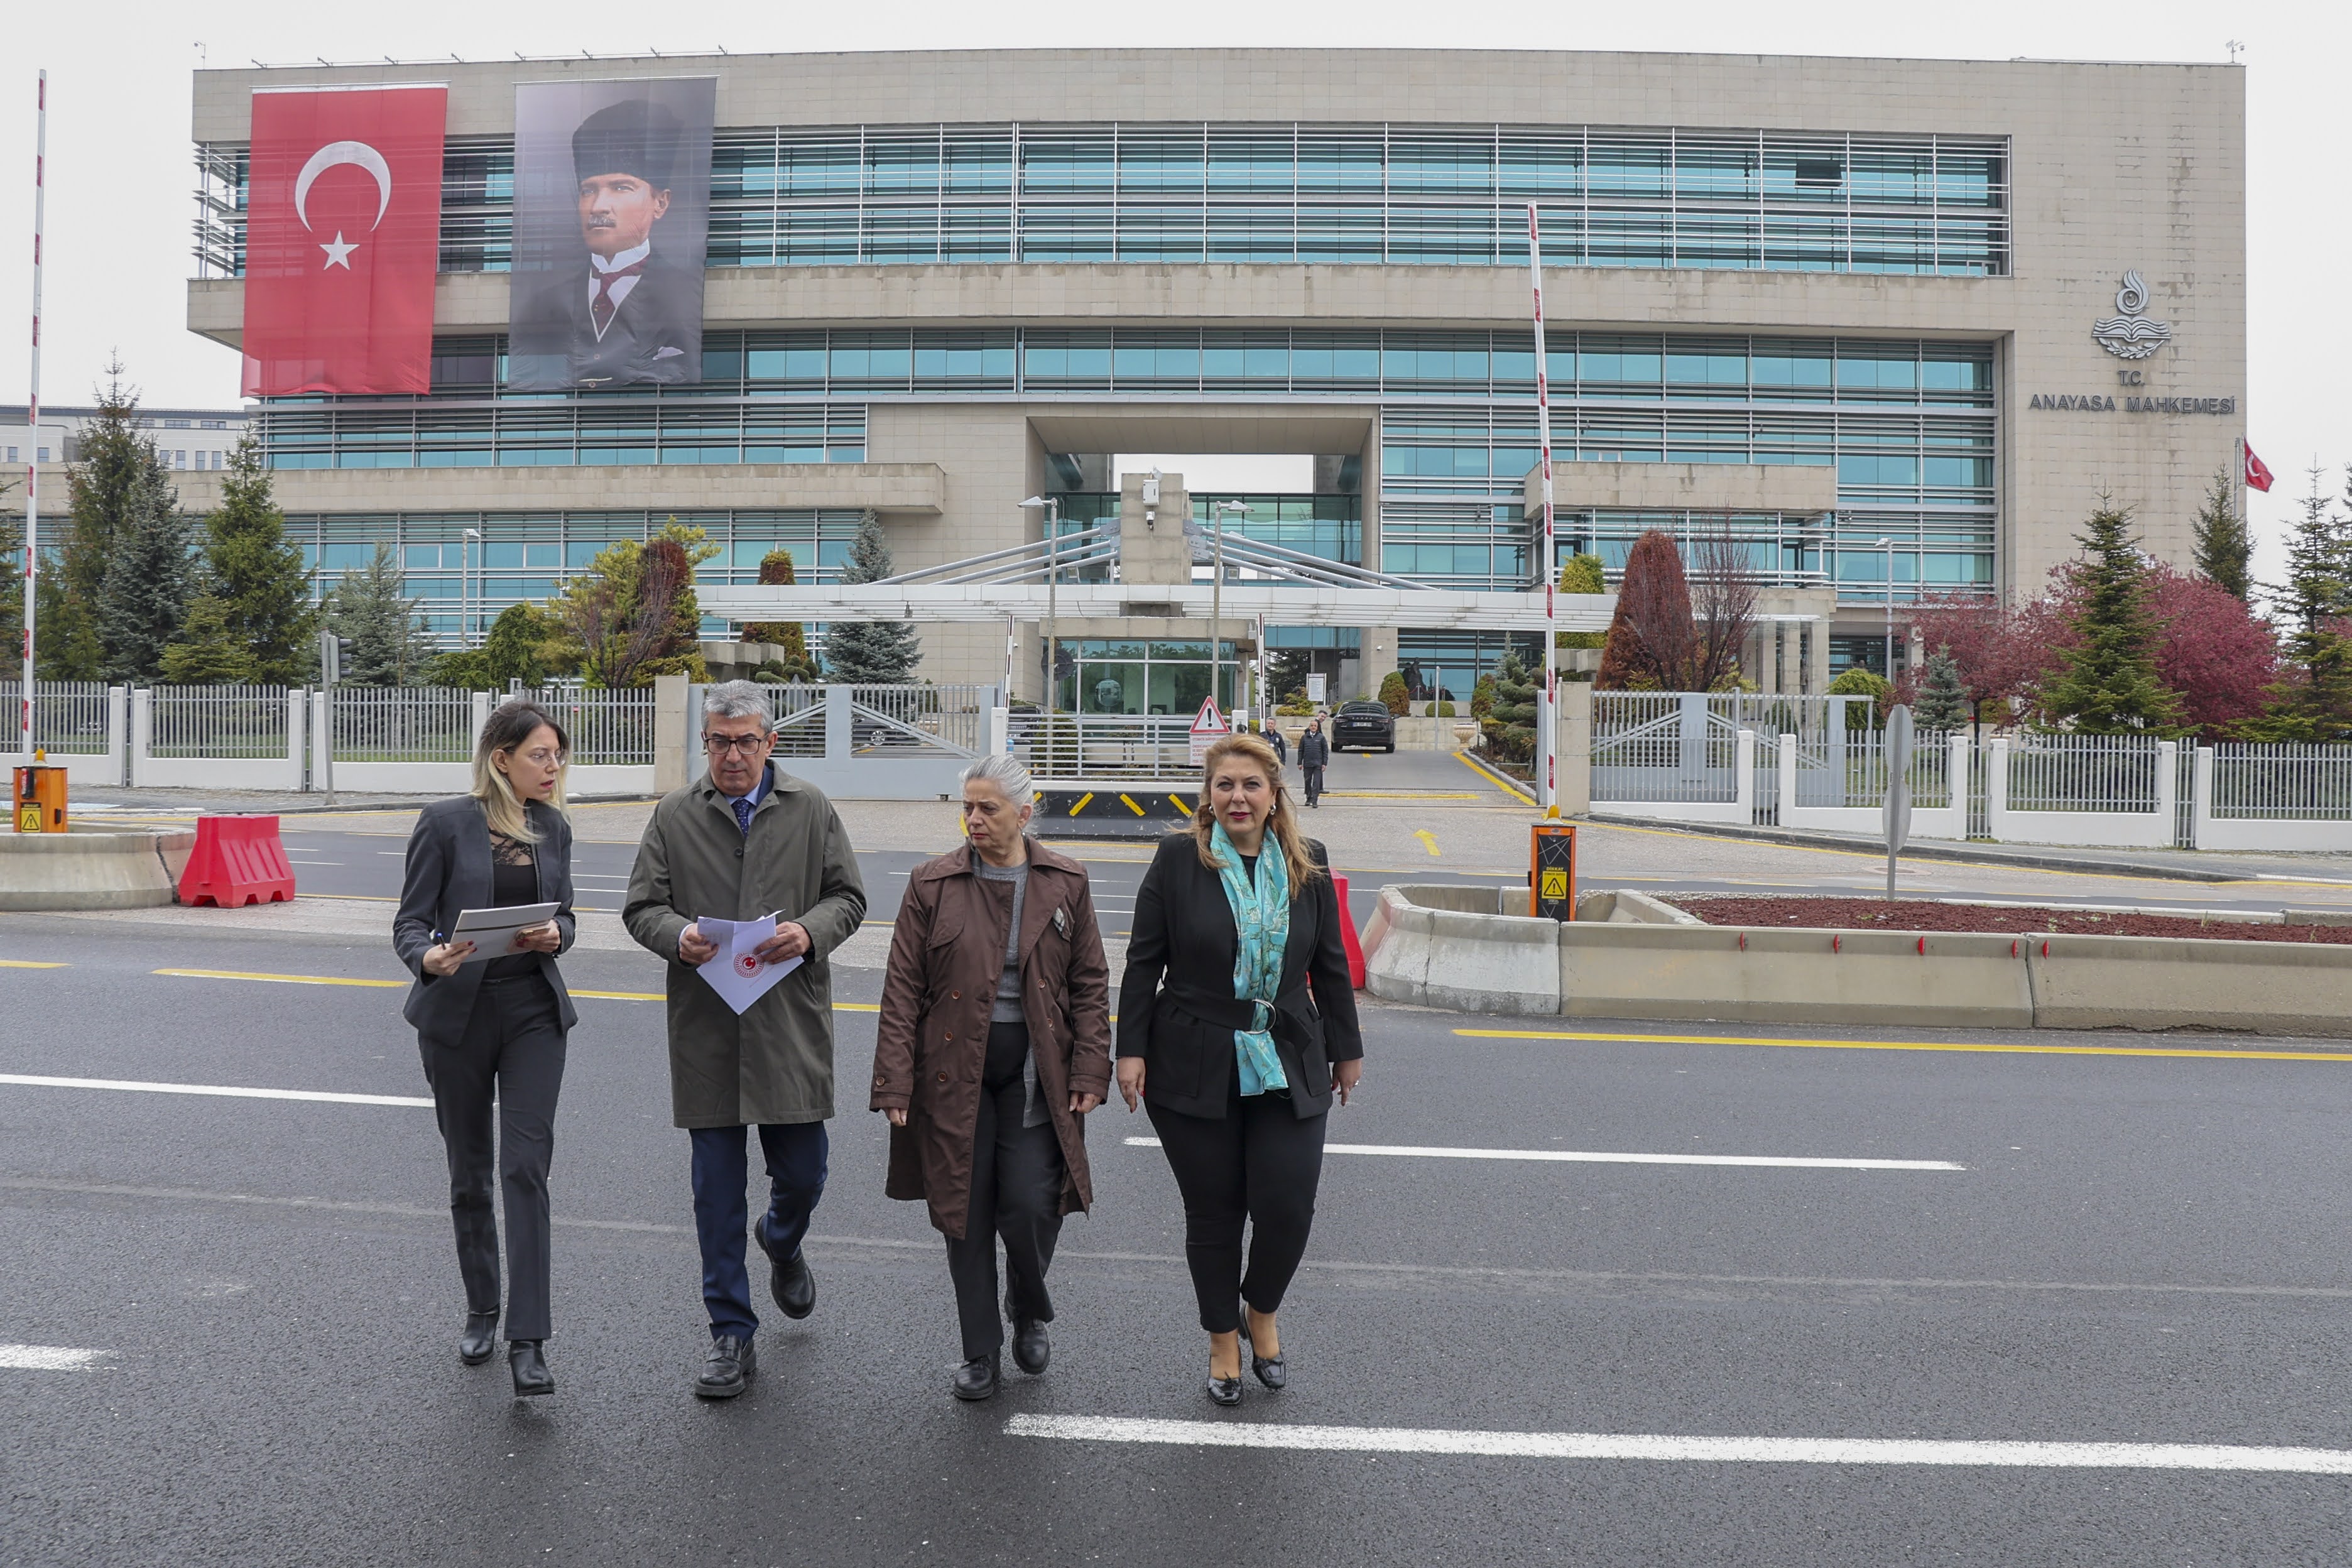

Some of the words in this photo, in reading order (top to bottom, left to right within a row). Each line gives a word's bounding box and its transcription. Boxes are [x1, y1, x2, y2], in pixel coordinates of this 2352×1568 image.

[2118, 370, 2145, 386] T.C.
[2030, 394, 2116, 412] ANAYASA
[2126, 395, 2236, 413] MAHKEMESİ
